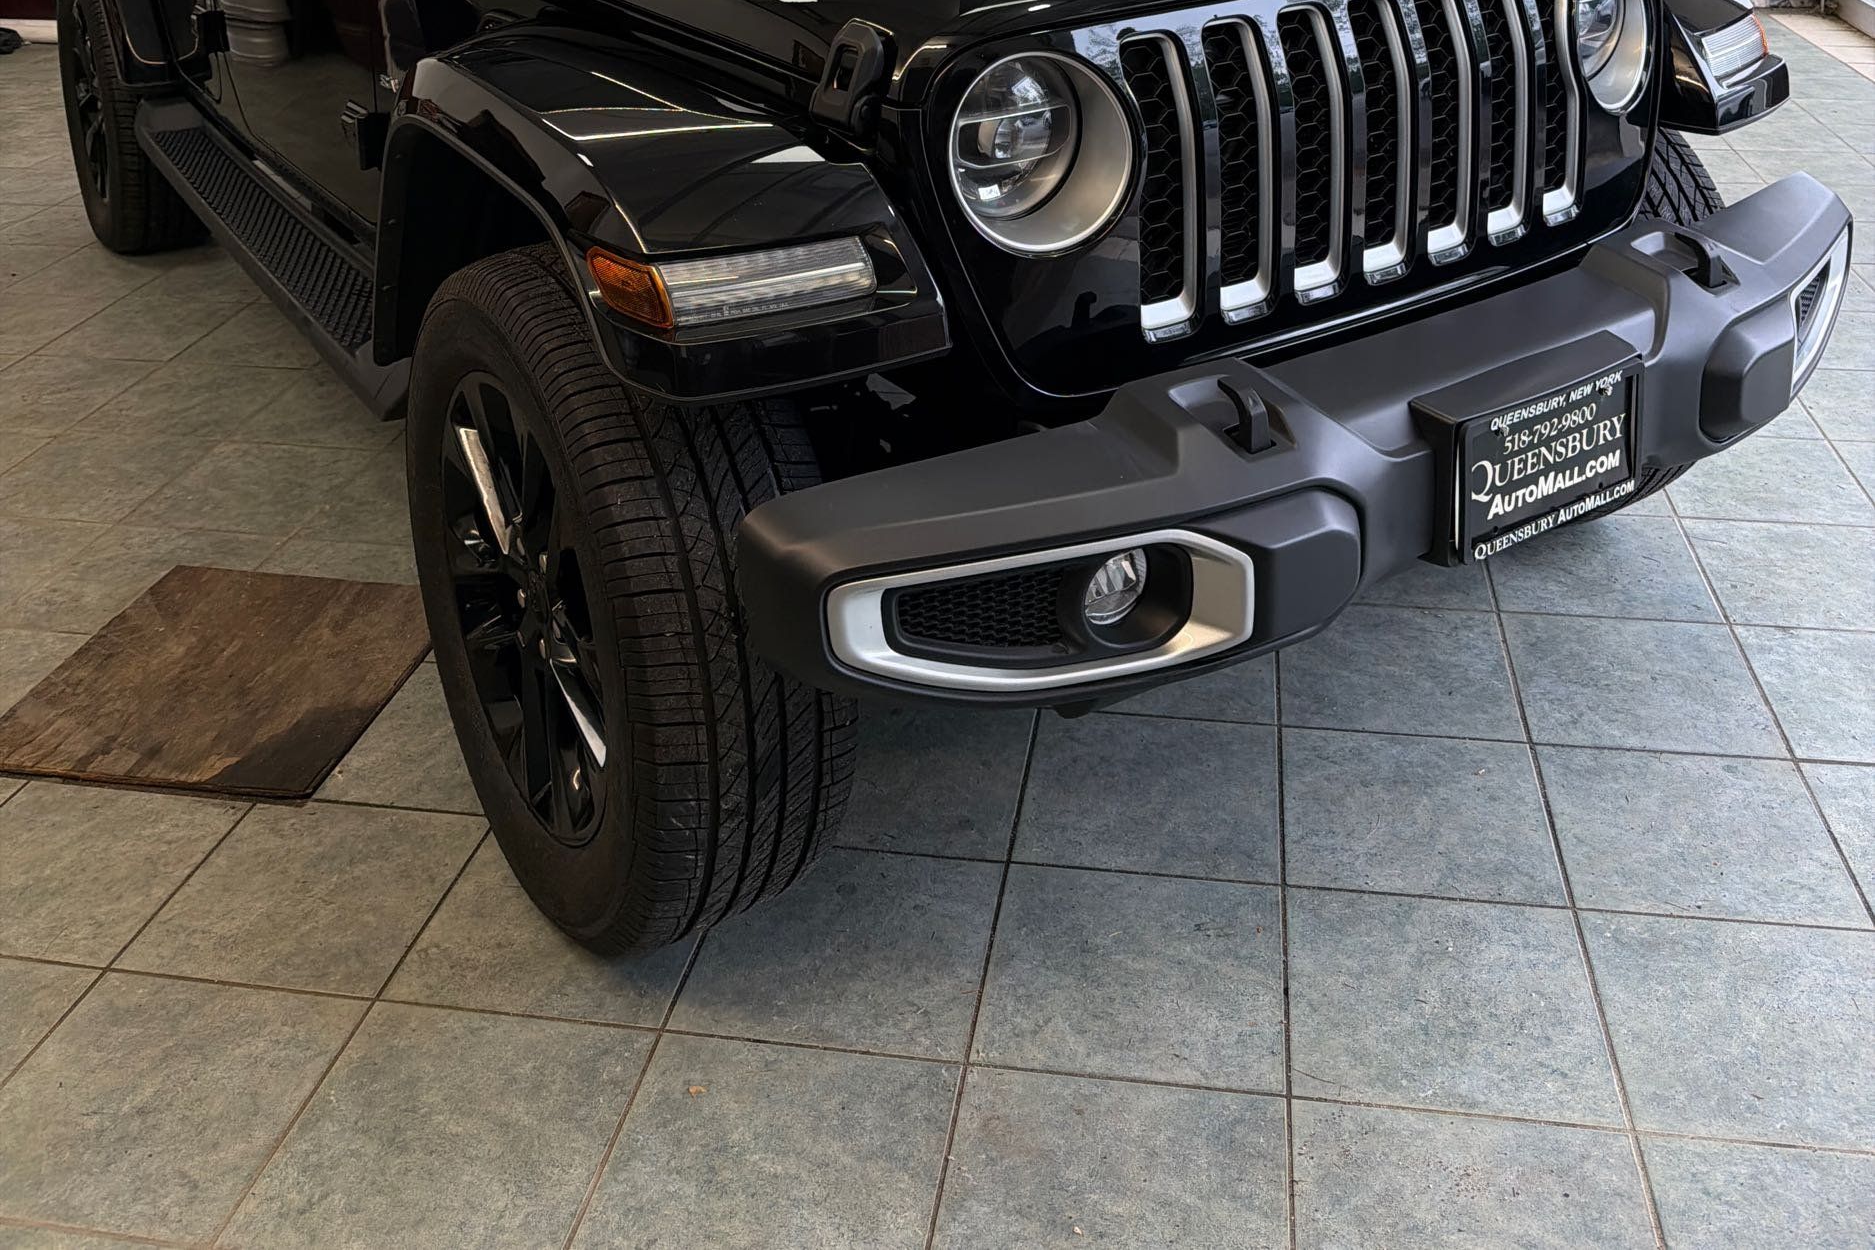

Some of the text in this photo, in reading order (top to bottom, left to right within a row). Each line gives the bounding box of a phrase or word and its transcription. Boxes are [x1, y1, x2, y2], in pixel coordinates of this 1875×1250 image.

[1490, 370, 1623, 431] QUEENSBURY, NEW YORK
[1502, 402, 1597, 455] 518-792-9800
[1471, 412, 1626, 502] QUEENSBURY
[1474, 514, 1557, 561] QUEENSBURY
